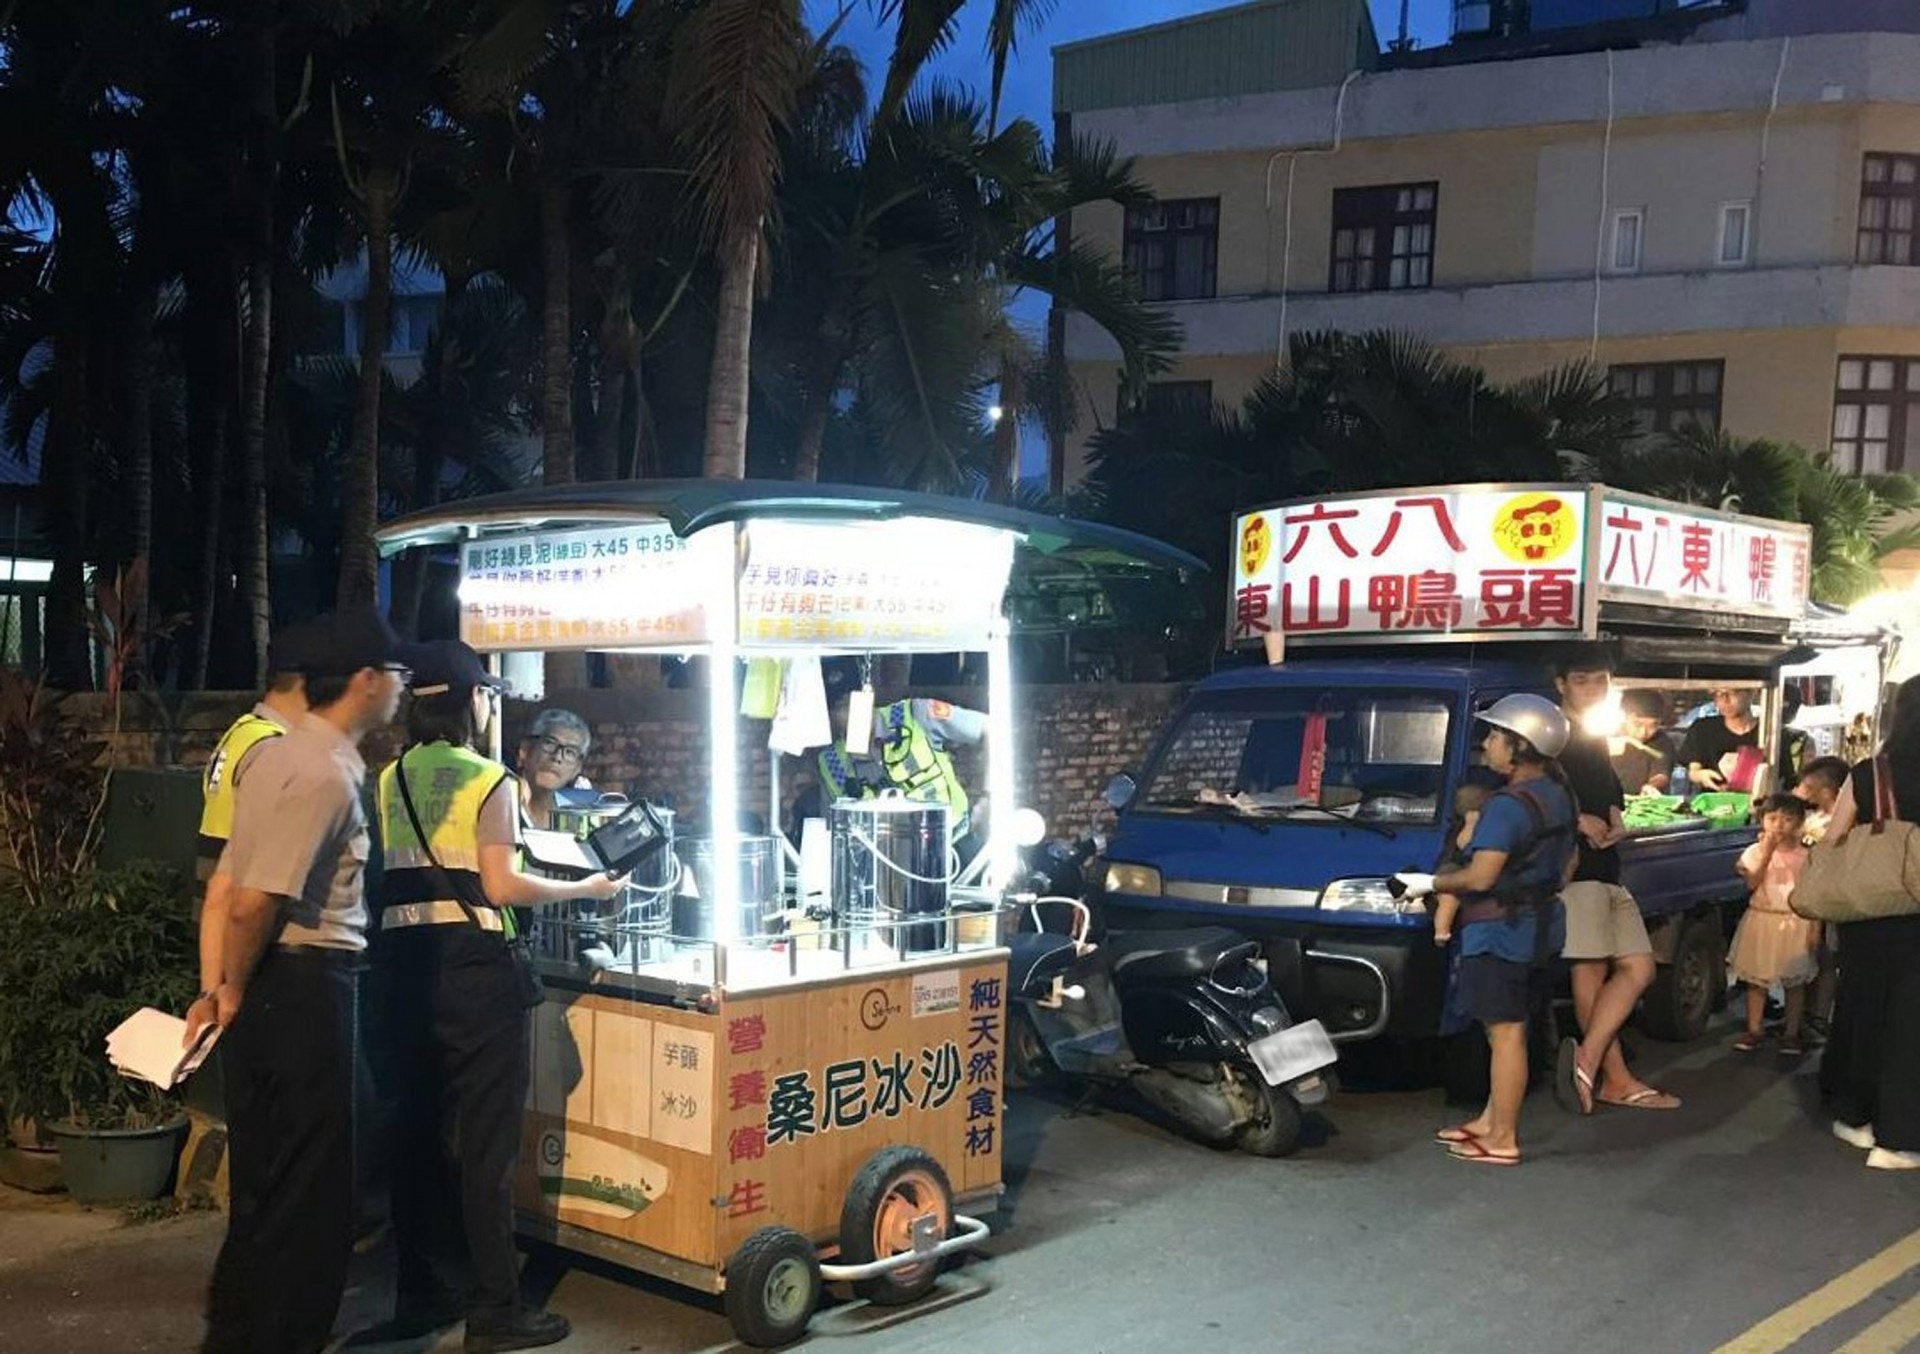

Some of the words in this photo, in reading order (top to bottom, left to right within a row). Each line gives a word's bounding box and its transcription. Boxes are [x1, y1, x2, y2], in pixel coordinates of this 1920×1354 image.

[592, 538, 628, 558] 大45
[1282, 497, 1467, 564] 六八
[1236, 569, 1577, 636] 東山鴨頭
[663, 1041, 699, 1071] 芋頭
[965, 978, 1001, 1157] 純天然食材
[660, 1090, 698, 1120] 冰沙
[728, 1014, 768, 1218] 營養衛生
[766, 1042, 962, 1145] 桑尼冰沙
